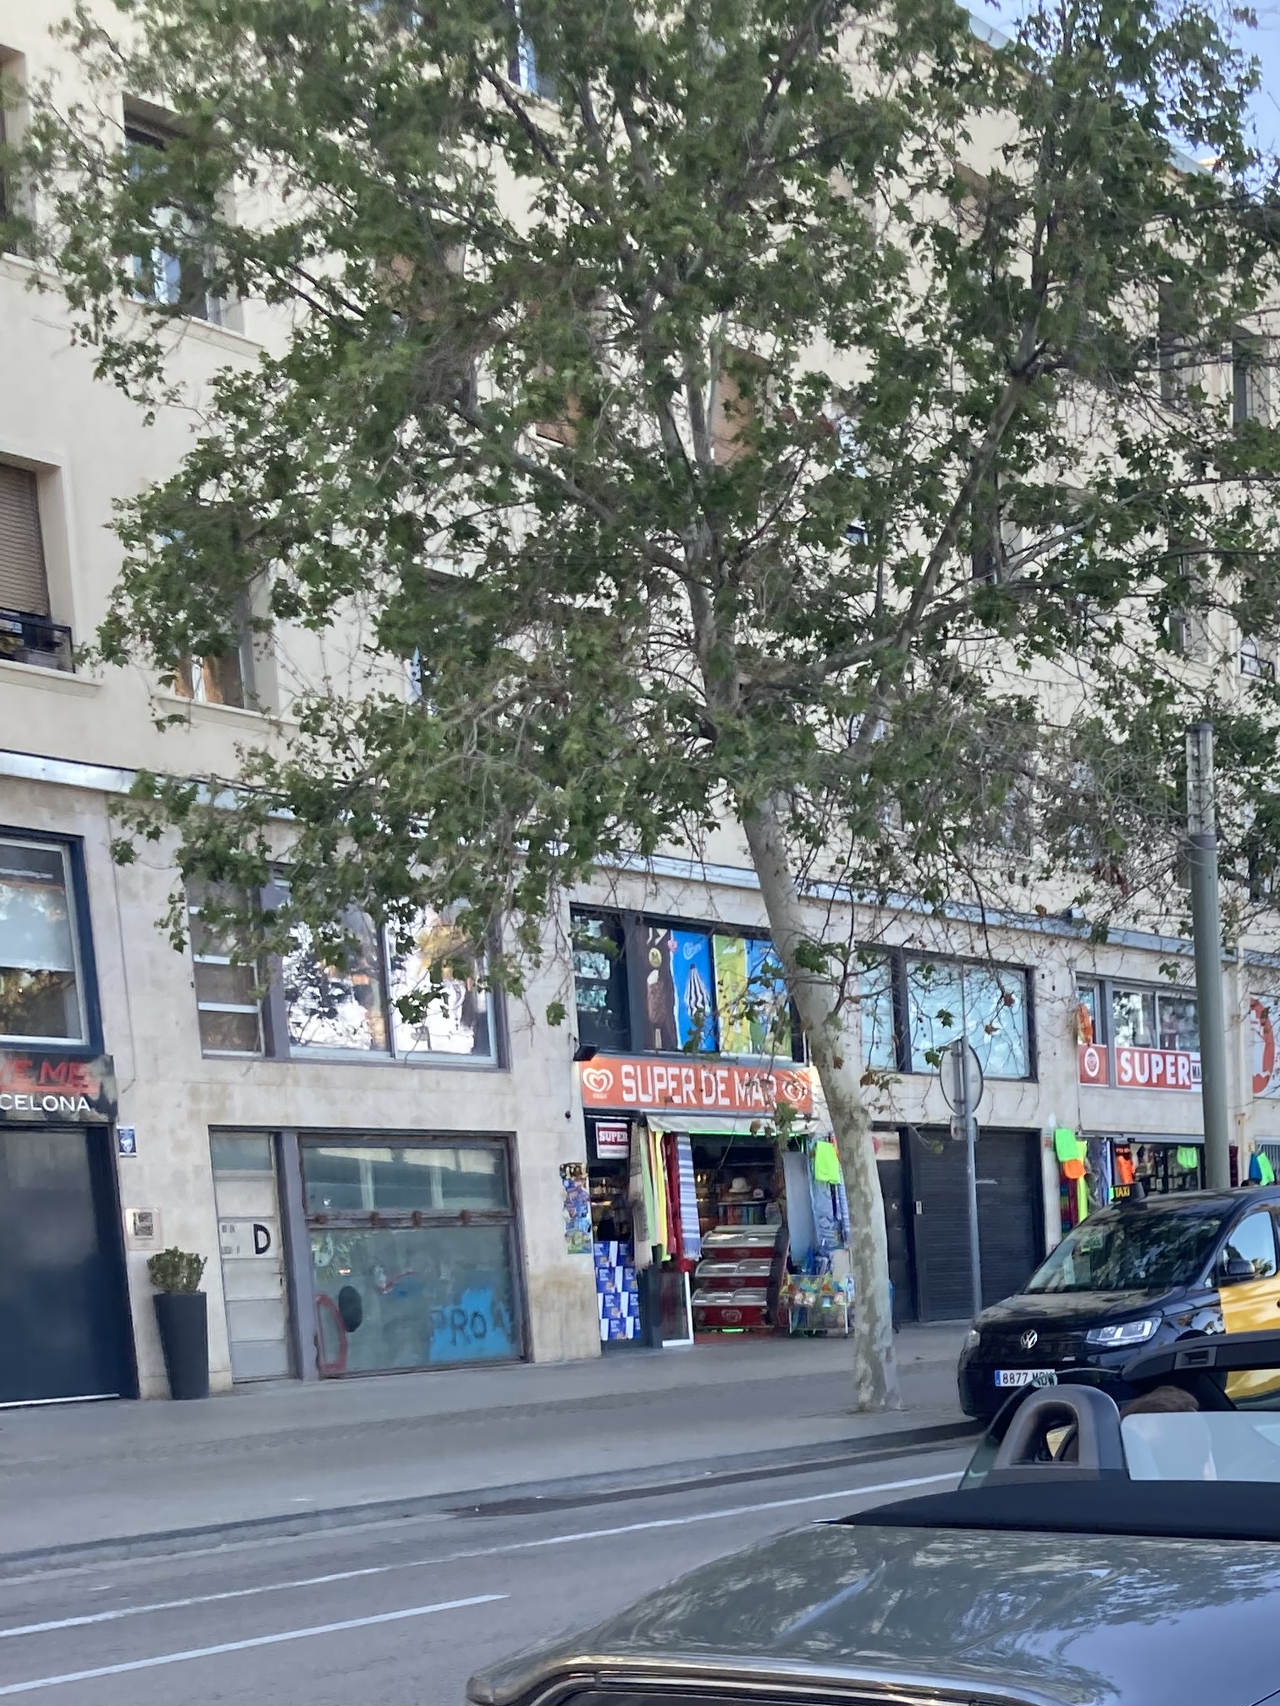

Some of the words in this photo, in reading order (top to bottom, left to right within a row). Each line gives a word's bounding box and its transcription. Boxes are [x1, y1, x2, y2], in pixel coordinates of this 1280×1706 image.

[1120, 1051, 1190, 1086] SUPER
[620, 1064, 698, 1105] SUPER
[701, 1068, 731, 1106] DE
[1115, 1186, 1131, 1198] TAXI
[253, 1223, 272, 1255] D
[1002, 1372, 1029, 1385] 8877
